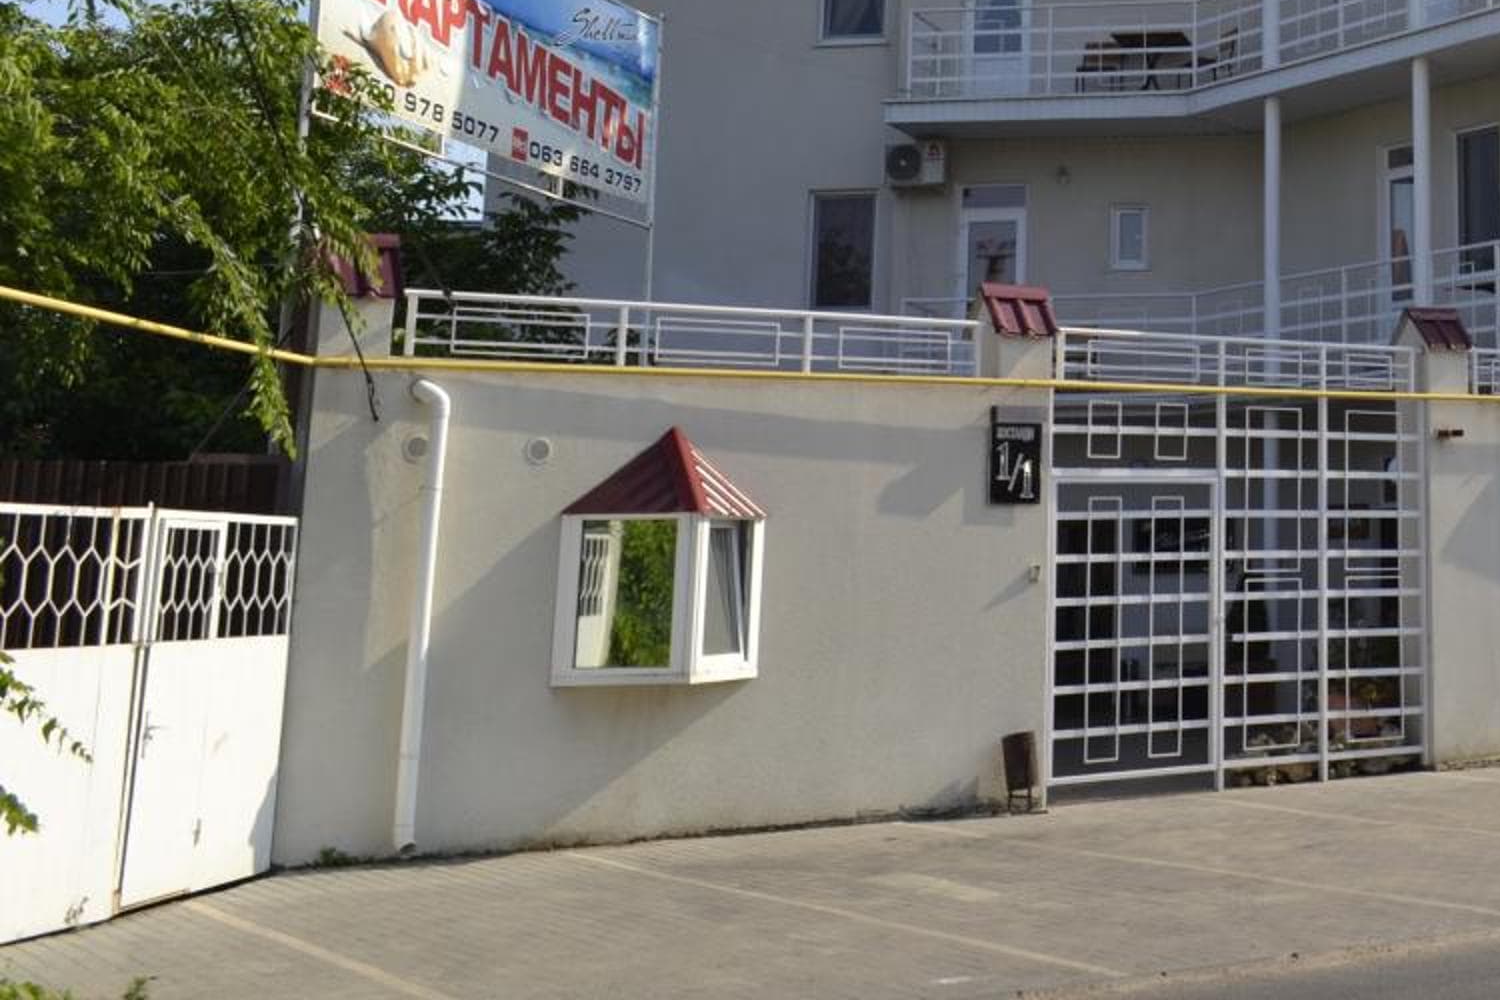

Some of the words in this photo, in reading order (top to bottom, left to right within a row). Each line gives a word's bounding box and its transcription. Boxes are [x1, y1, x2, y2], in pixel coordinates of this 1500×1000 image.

[405, 92, 444, 123] 978
[451, 111, 499, 143] 5077
[529, 141, 563, 167] 063
